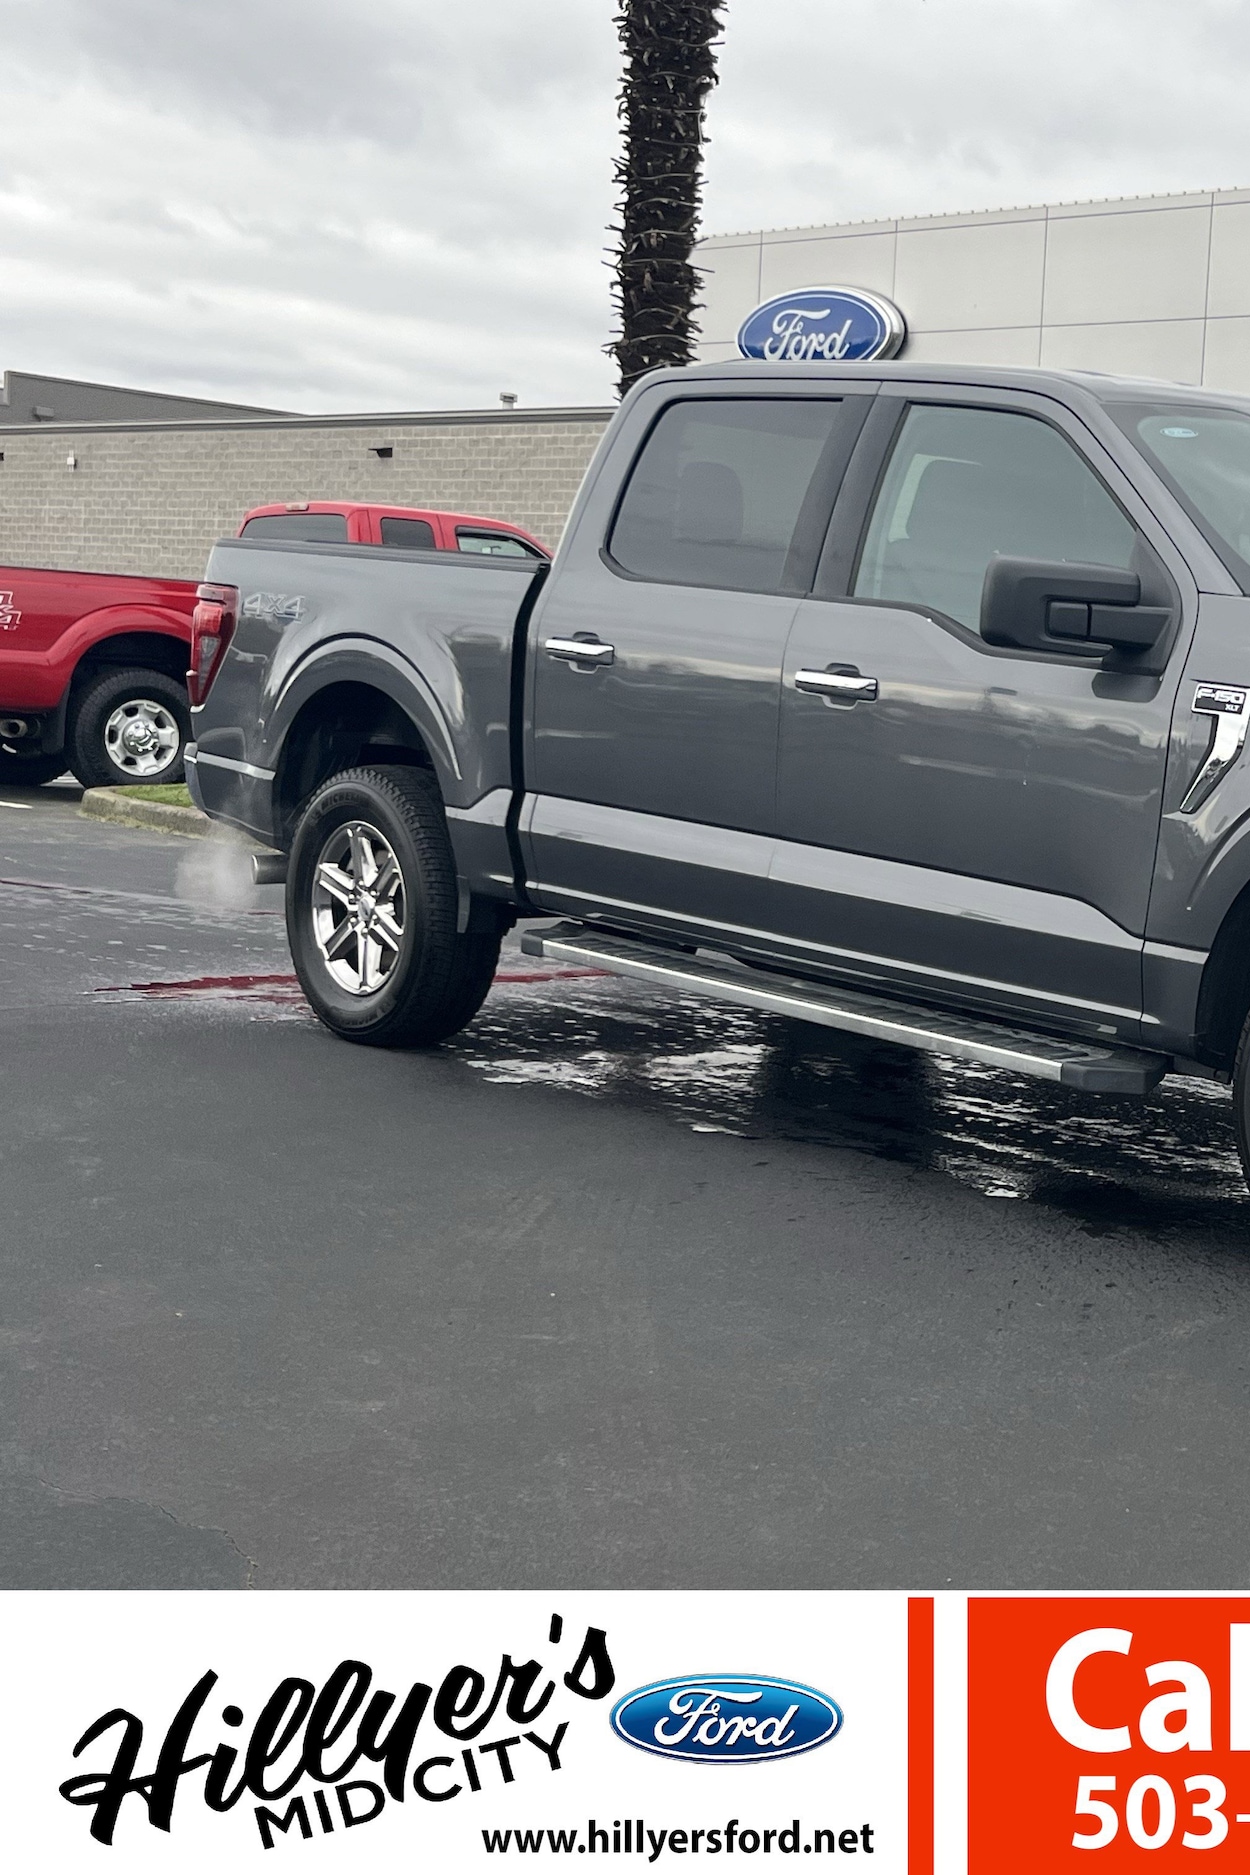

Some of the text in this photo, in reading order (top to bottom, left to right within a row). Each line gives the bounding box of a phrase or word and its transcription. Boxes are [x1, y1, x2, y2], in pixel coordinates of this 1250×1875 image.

[764, 309, 852, 361] Ford
[1197, 687, 1245, 704] F-150
[1224, 703, 1240, 712] XLT
